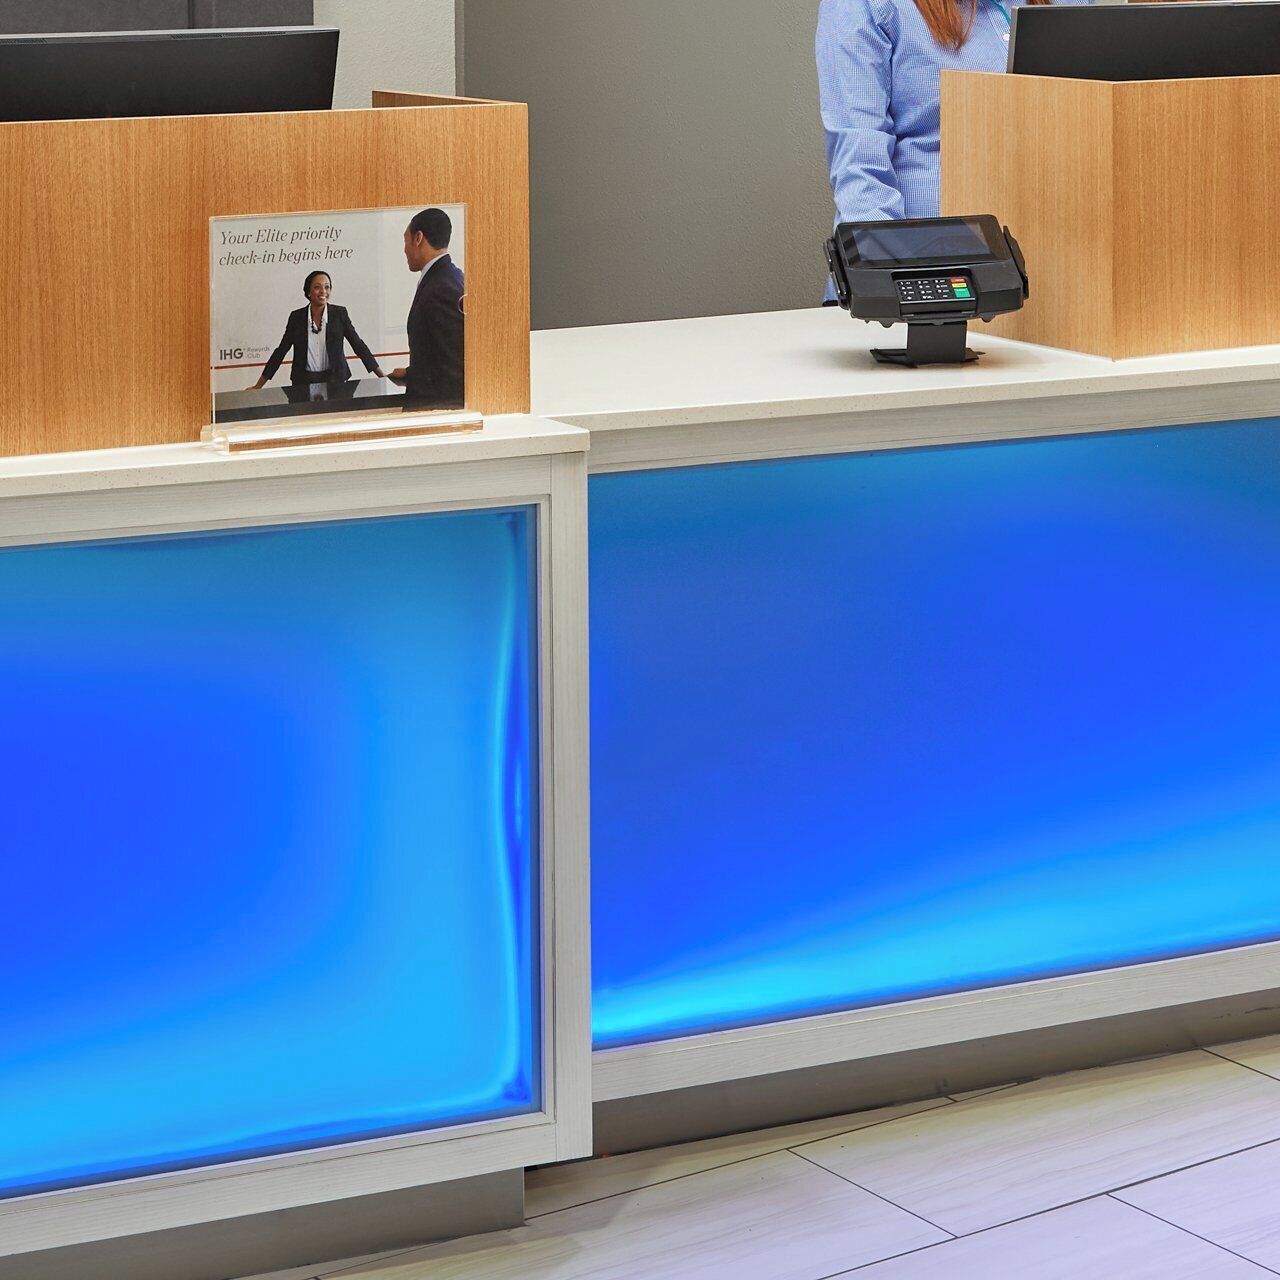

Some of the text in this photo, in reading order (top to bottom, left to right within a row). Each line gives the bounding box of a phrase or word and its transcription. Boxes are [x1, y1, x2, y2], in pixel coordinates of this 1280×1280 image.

[219, 225, 342, 245] Your Elite priority
[219, 246, 354, 266] check-in begins here
[220, 348, 243, 360] IHG
